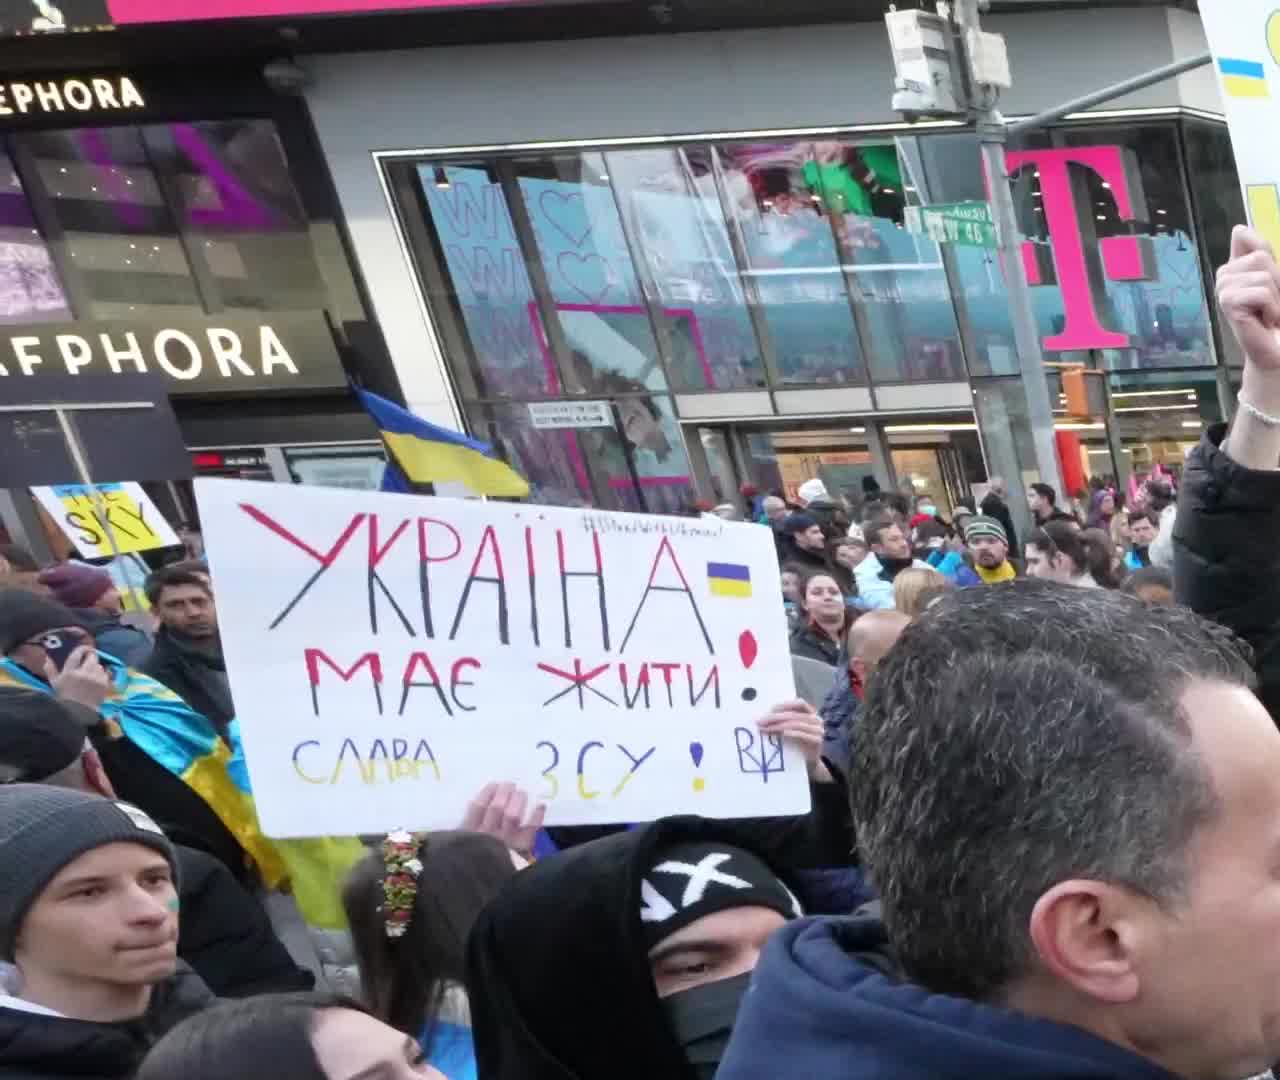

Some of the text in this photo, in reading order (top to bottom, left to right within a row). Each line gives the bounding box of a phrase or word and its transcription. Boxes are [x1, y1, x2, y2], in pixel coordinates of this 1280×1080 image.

[65, 501, 156, 545] SKY
[239, 502, 715, 655] УКРАЇНА
[304, 648, 481, 717] МАЄ
[292, 737, 441, 785] СЛАВА
